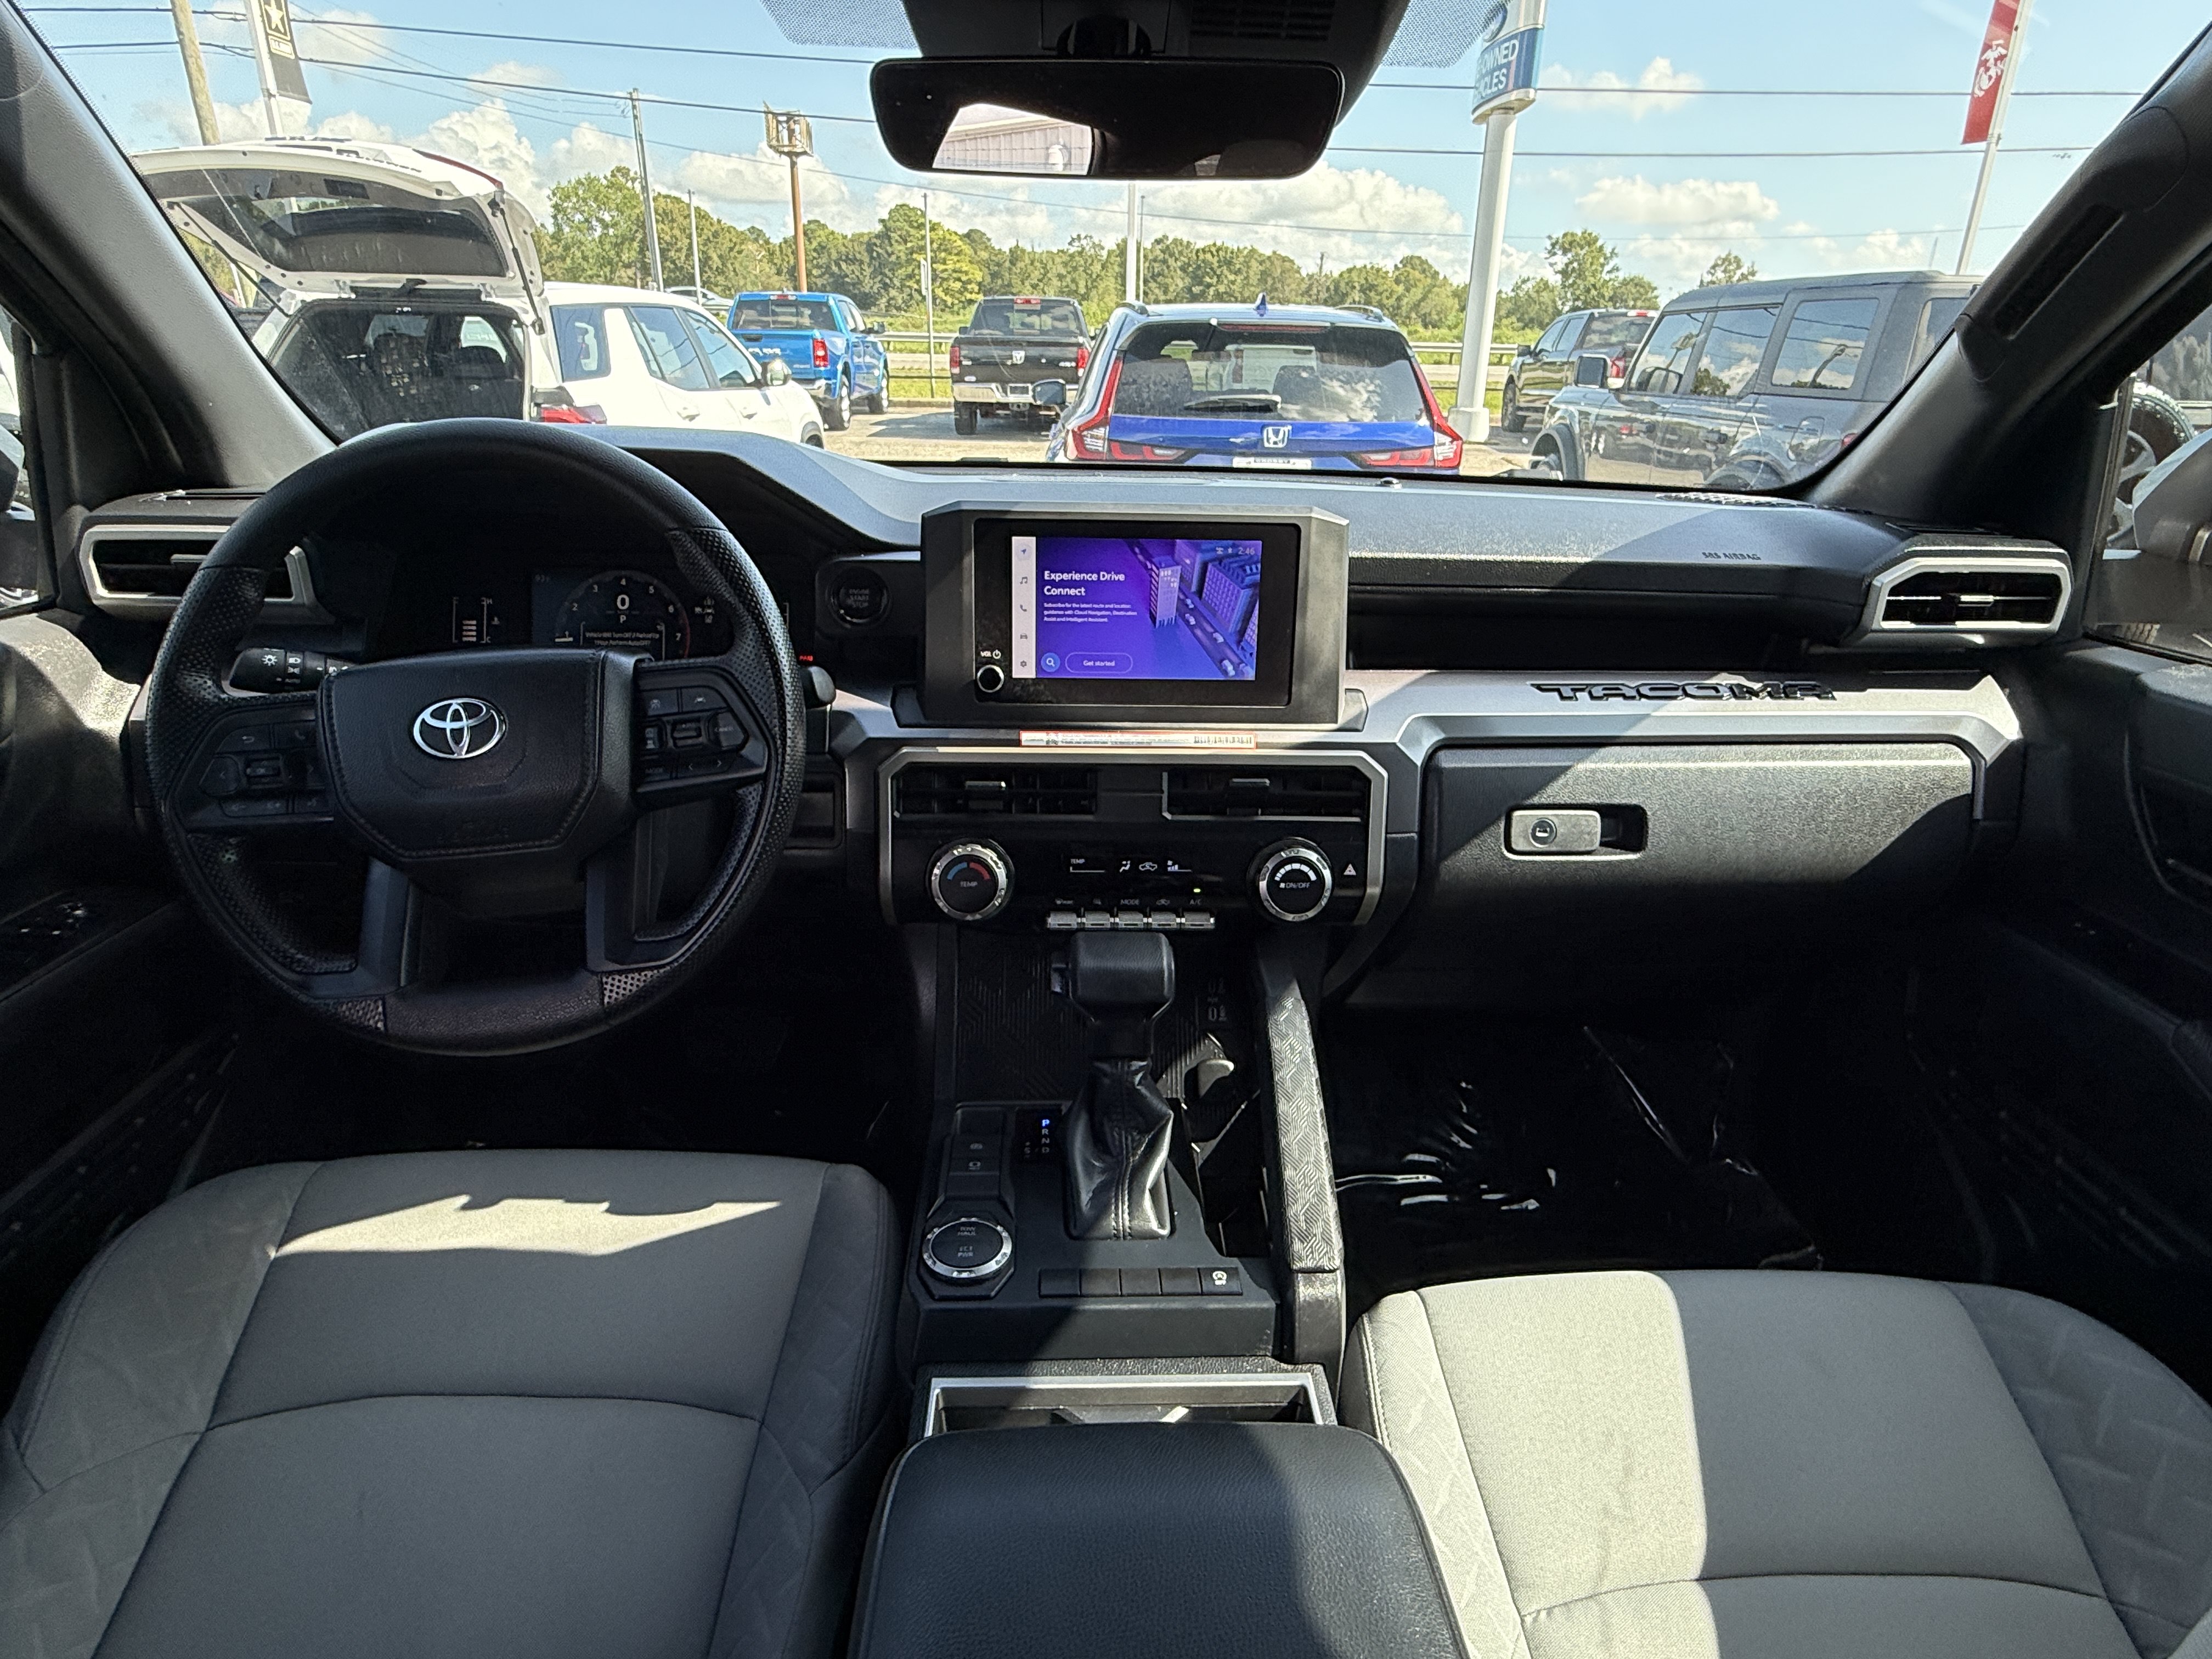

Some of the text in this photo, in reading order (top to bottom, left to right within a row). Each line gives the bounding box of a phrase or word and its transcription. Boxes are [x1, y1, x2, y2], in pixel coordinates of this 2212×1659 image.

[1238, 547, 1255, 555] 2:46
[1723, 552, 1762, 561] AIRBAG
[1044, 571, 1125, 582] Experience Drive
[592, 584, 599, 592] 3
[648, 585, 655, 594] 5
[1044, 585, 1086, 596] Connect
[572, 602, 578, 611] 2
[616, 594, 630, 610] 0
[668, 605, 674, 613] 6
[619, 614, 627, 624] P
[1530, 681, 1837, 701] TACOMA
